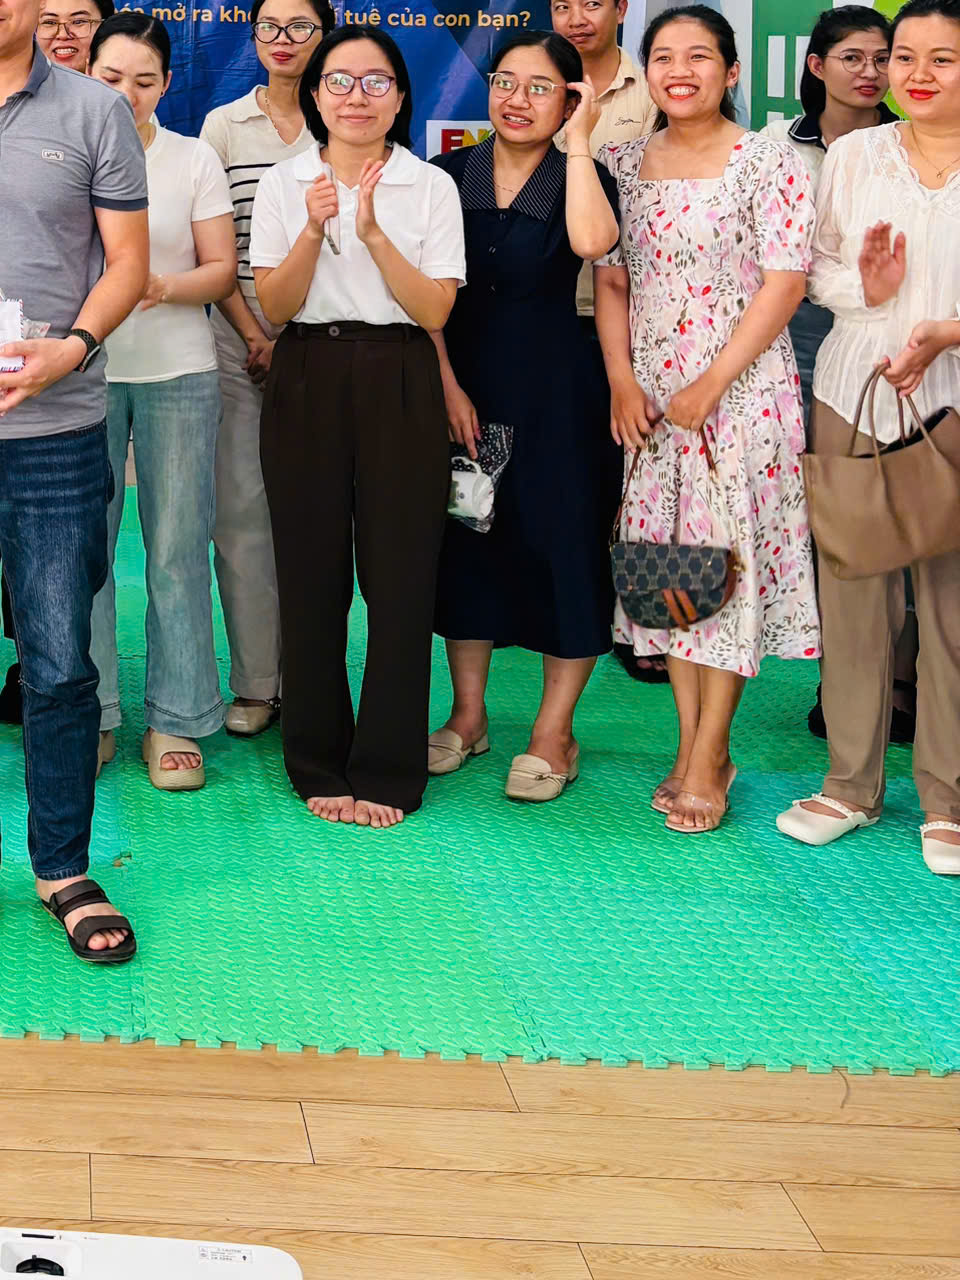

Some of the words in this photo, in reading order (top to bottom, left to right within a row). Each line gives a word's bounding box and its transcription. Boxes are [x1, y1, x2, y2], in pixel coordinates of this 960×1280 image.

[193, 8, 213, 22] ra
[387, 7, 427, 26] của
[433, 12, 470, 27] con
[478, 10, 531, 31] bạn?
